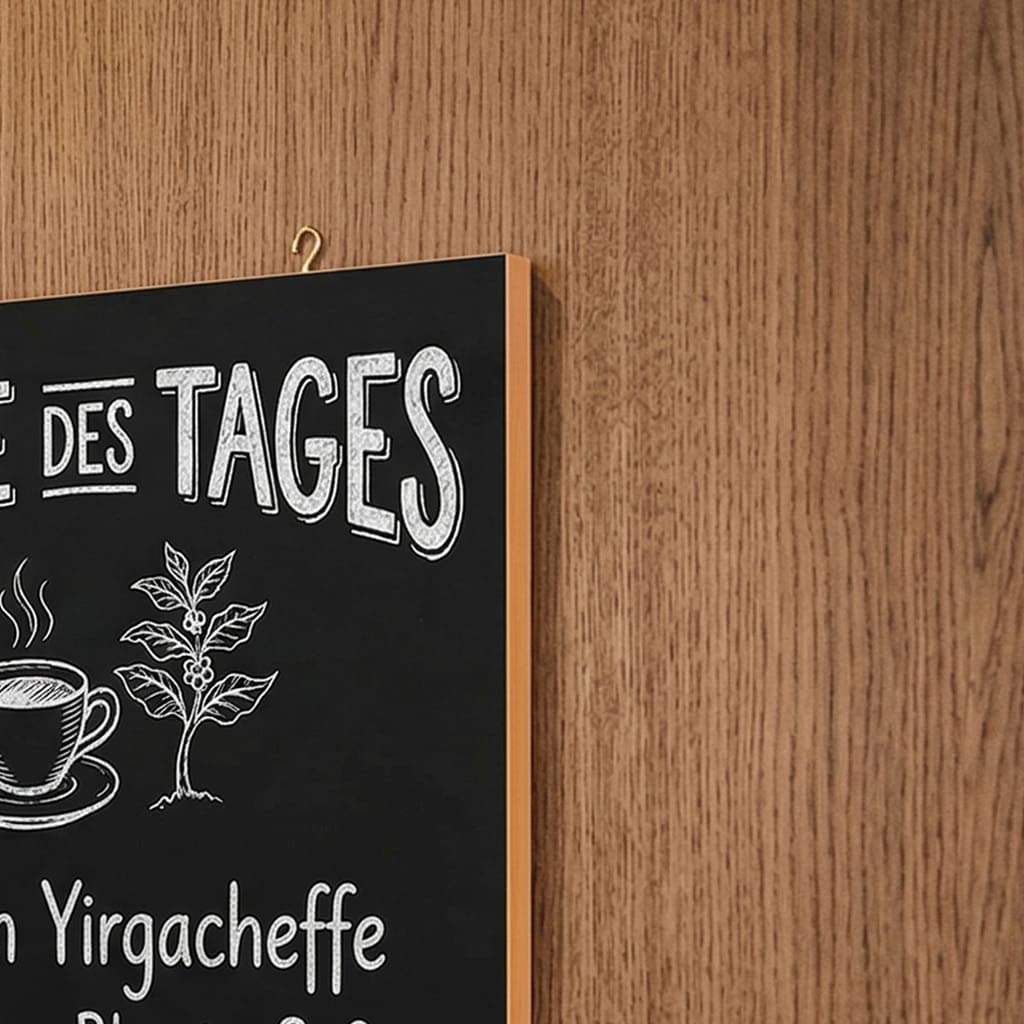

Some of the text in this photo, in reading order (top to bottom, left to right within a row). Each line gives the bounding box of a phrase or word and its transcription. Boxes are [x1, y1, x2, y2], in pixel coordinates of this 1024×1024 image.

[43, 399, 136, 479] DES
[156, 345, 464, 561] TAGES
[40, 879, 386, 1002] Yirgacheffe
